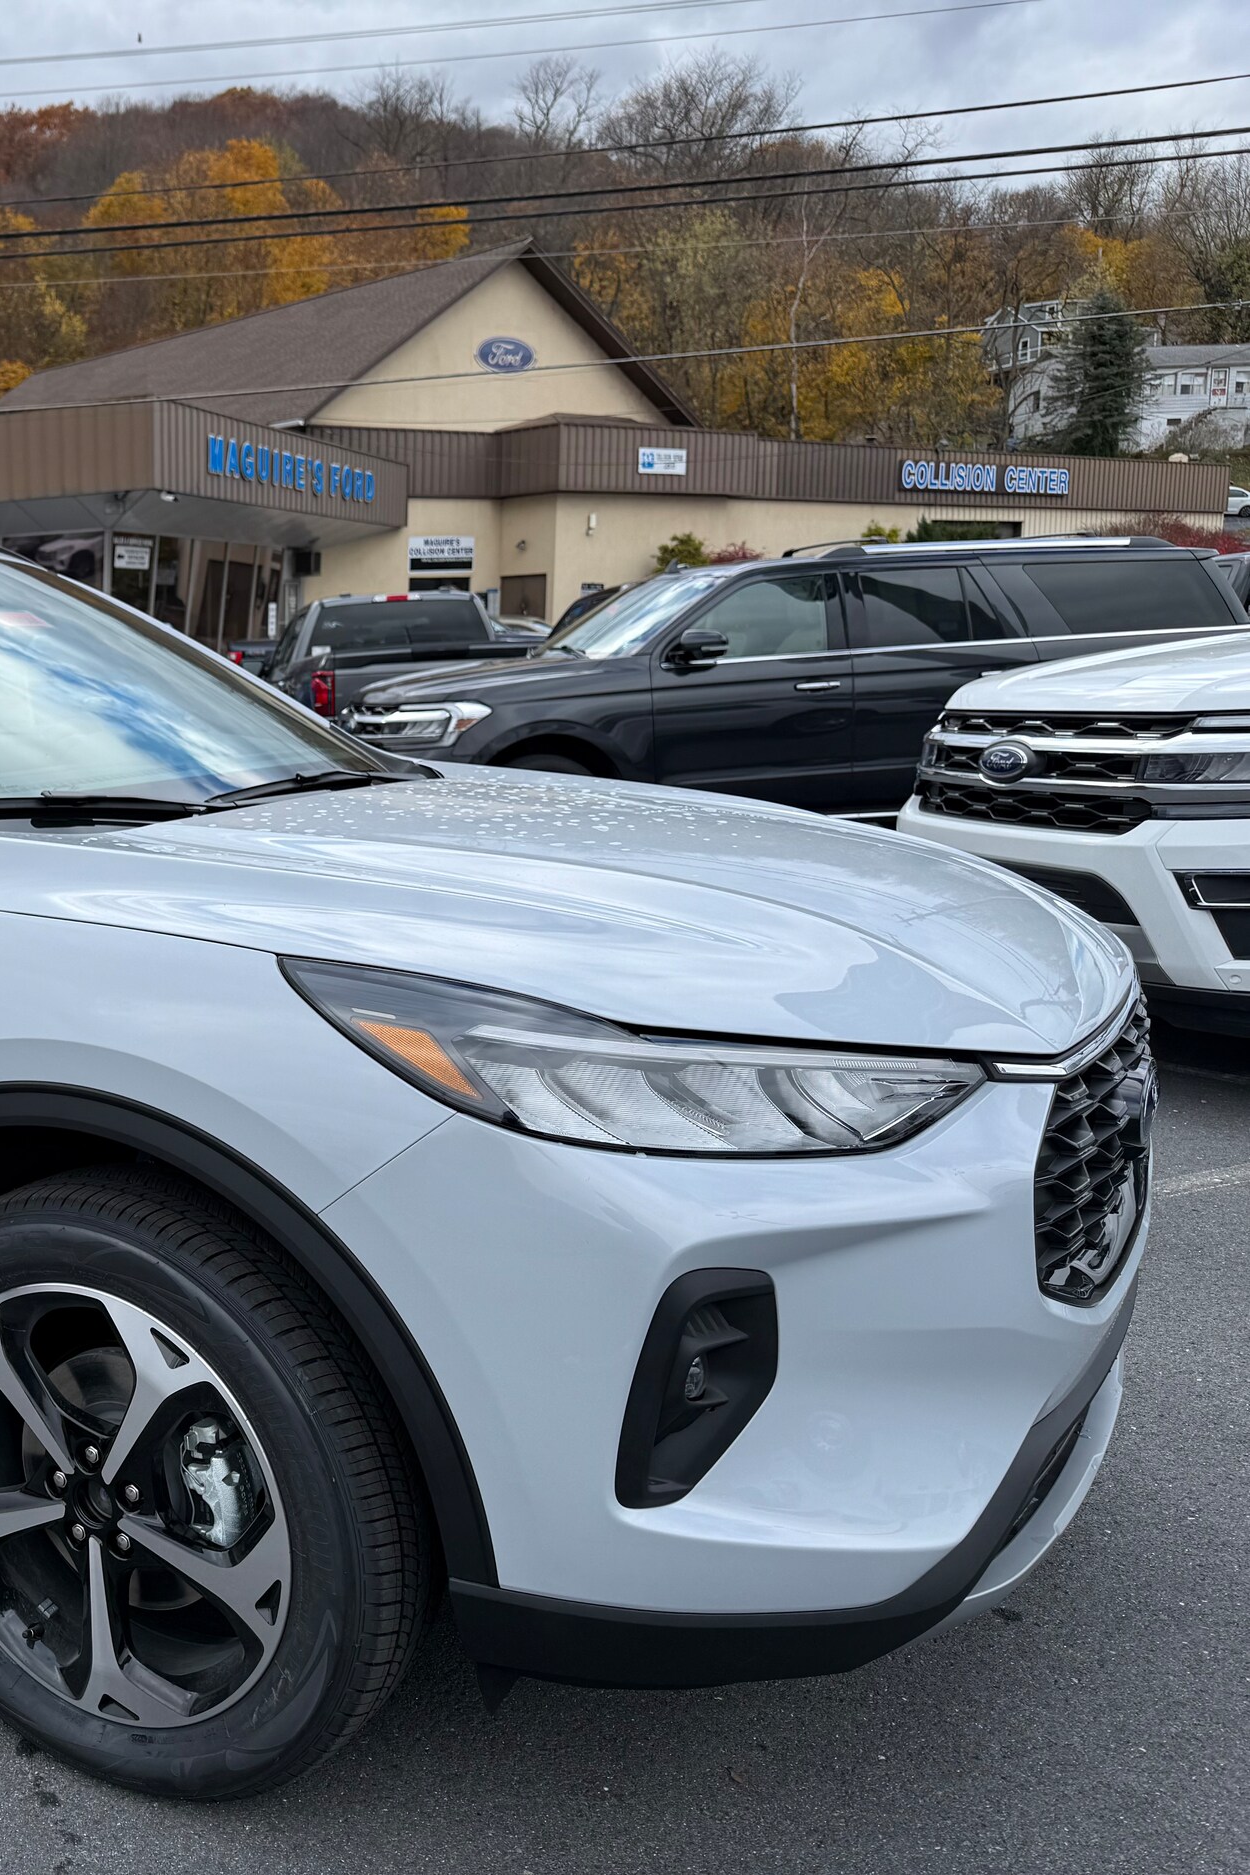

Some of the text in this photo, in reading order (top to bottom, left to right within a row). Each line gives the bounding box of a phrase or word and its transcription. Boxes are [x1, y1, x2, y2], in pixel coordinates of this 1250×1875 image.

[488, 342, 524, 366] Ford
[207, 434, 375, 503] MAGUIRE'S FORD
[902, 460, 1069, 494] COLLISION CENTER
[409, 547, 473, 555] COLLISION CENTER
